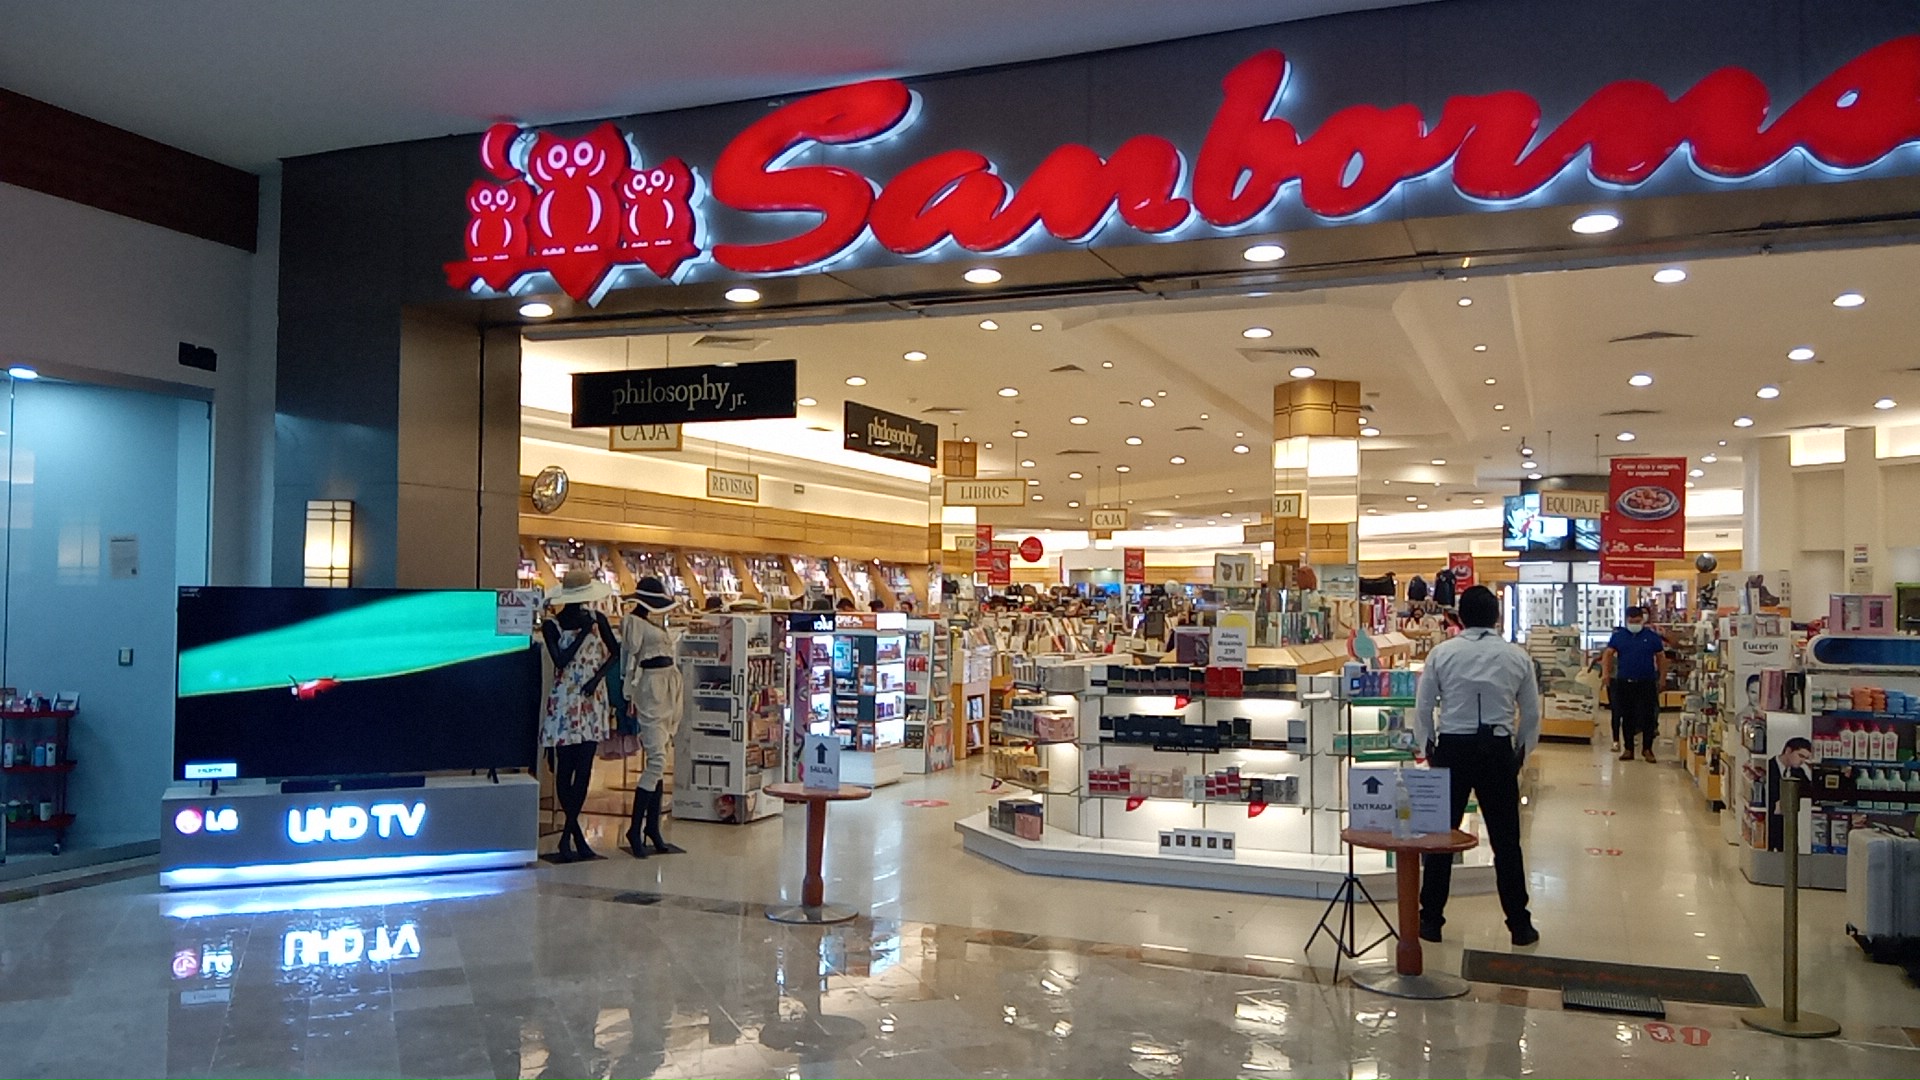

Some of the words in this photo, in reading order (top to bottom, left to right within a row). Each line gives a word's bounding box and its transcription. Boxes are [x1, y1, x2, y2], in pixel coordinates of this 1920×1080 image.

[611, 373, 730, 415] philosophy
[729, 392, 747, 411] jr.
[867, 416, 918, 454] philosophy
[712, 475, 753, 495] REVISTAS
[960, 486, 1010, 500] LIBROS
[1546, 496, 1601, 514] EQUIPAJE
[1095, 513, 1122, 525] CAJA
[1742, 641, 1779, 651] Eucerin
[810, 765, 833, 775] SALIDA
[1352, 803, 1393, 811] ENTRADA
[205, 808, 239, 832] LG
[287, 804, 369, 844] UHD
[370, 802, 426, 839] TV
